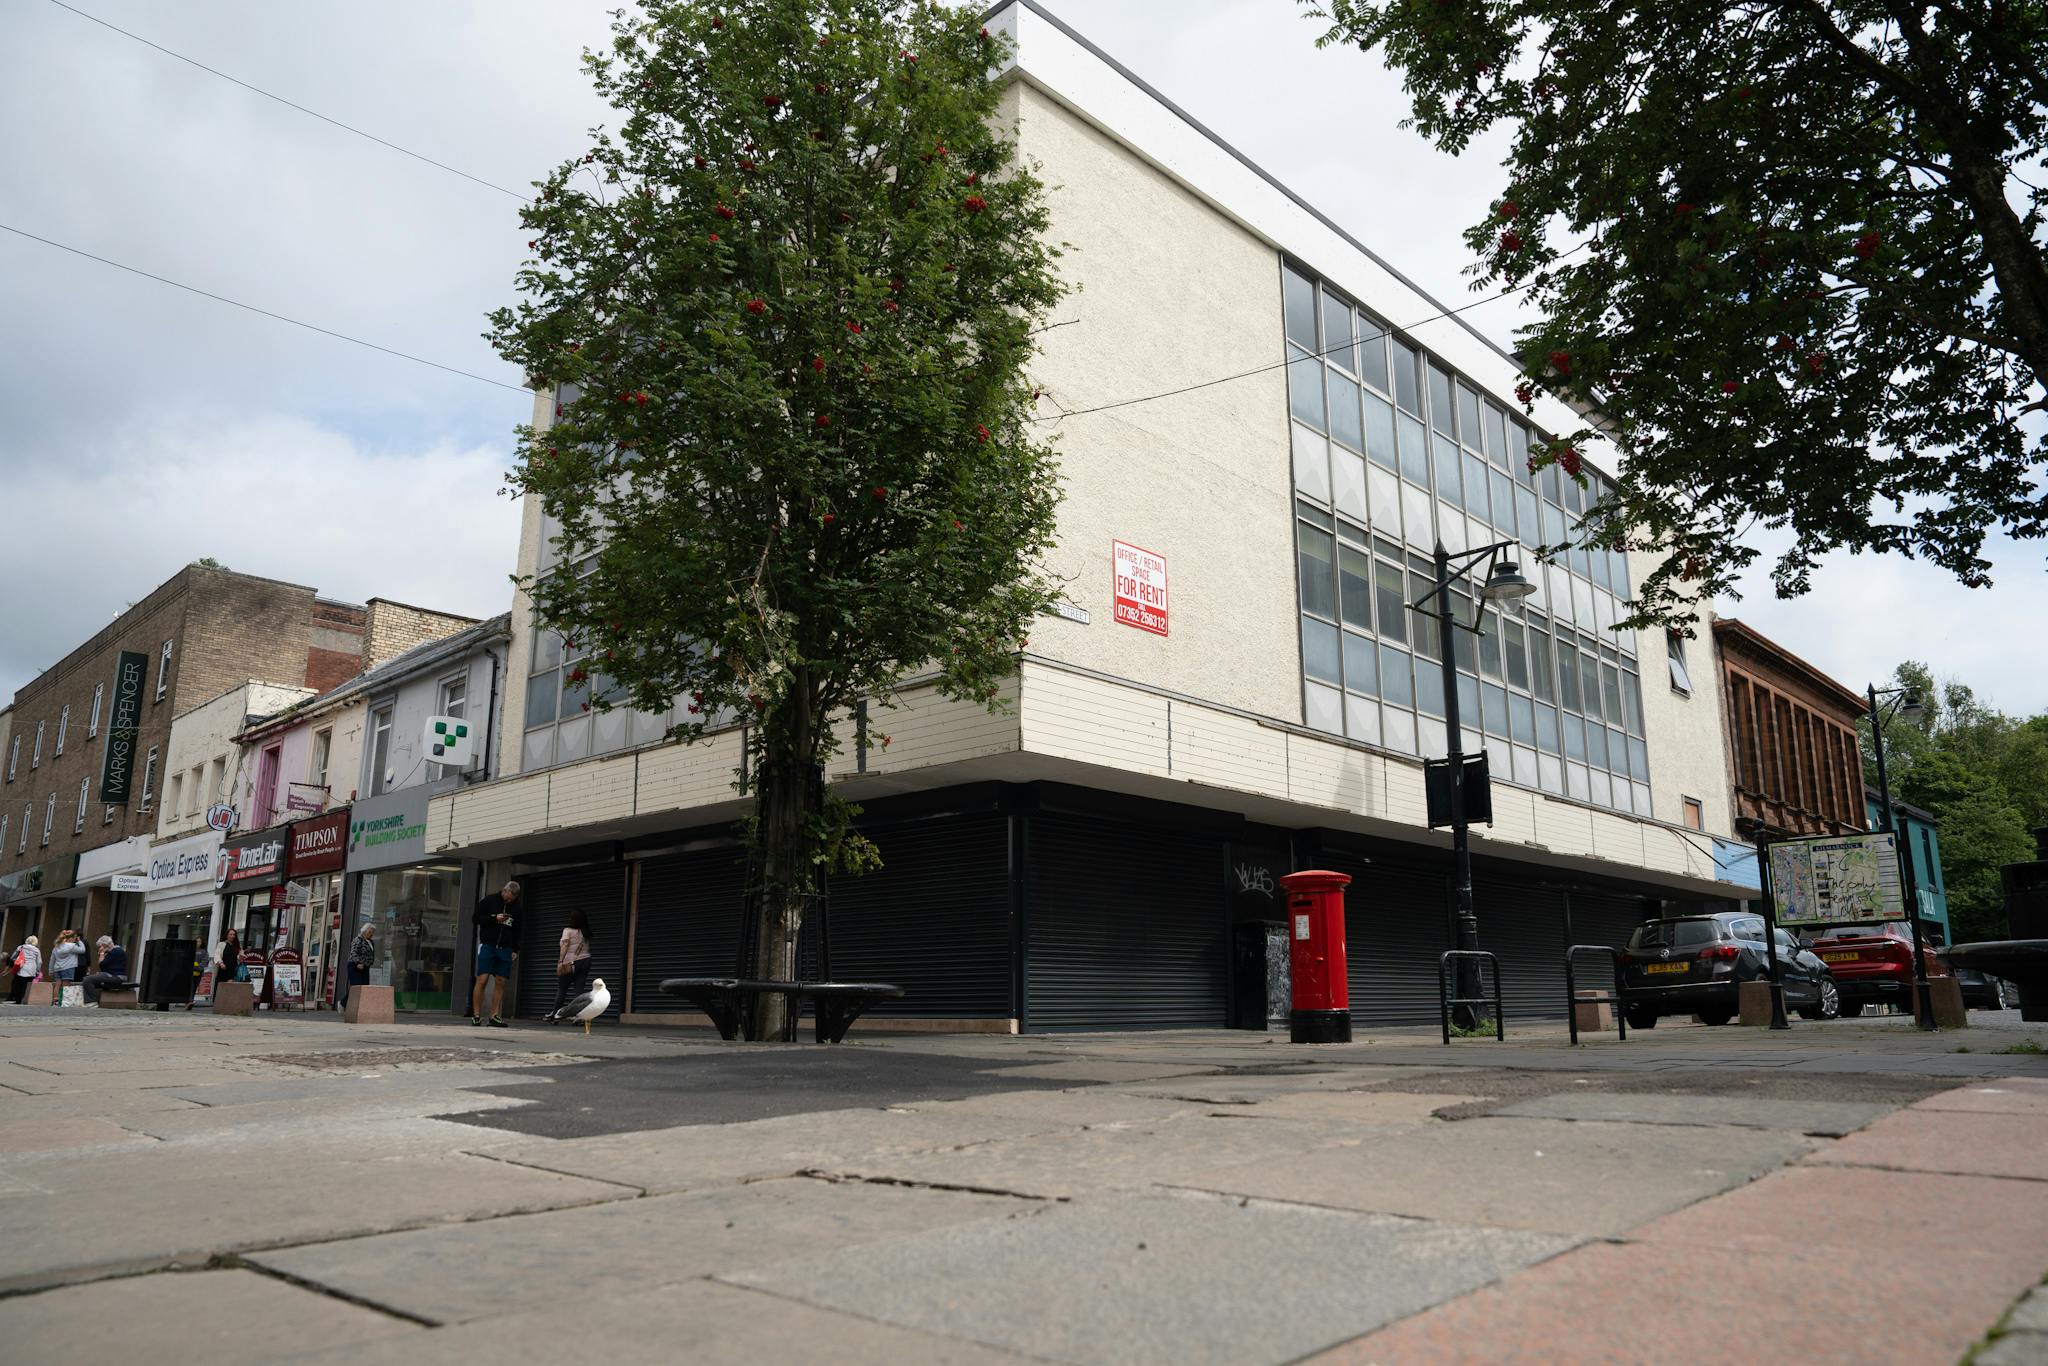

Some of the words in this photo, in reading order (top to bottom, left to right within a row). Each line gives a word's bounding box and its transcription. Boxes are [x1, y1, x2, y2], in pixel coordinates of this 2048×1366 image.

[1117, 547, 1138, 565] OFFICE
[1143, 556, 1163, 574] RETAIL
[1131, 565, 1151, 582] SPACE
[1117, 574, 1137, 598] FOR
[1139, 582, 1164, 607] RENT
[1062, 606, 1088, 621] STREET
[1117, 603, 1140, 622] 07352
[116, 663, 141, 729] SPENCER
[107, 740, 130, 794] MARKS
[365, 830, 397, 848] BUILDING
[397, 823, 428, 840] SOCIETY
[366, 814, 405, 832] YORKSHIRE
[295, 825, 339, 852] TIMPSON
[1815, 842, 1860, 851] KILMARNOCK
[151, 855, 177, 886] Optical
[178, 853, 209, 880] Express
